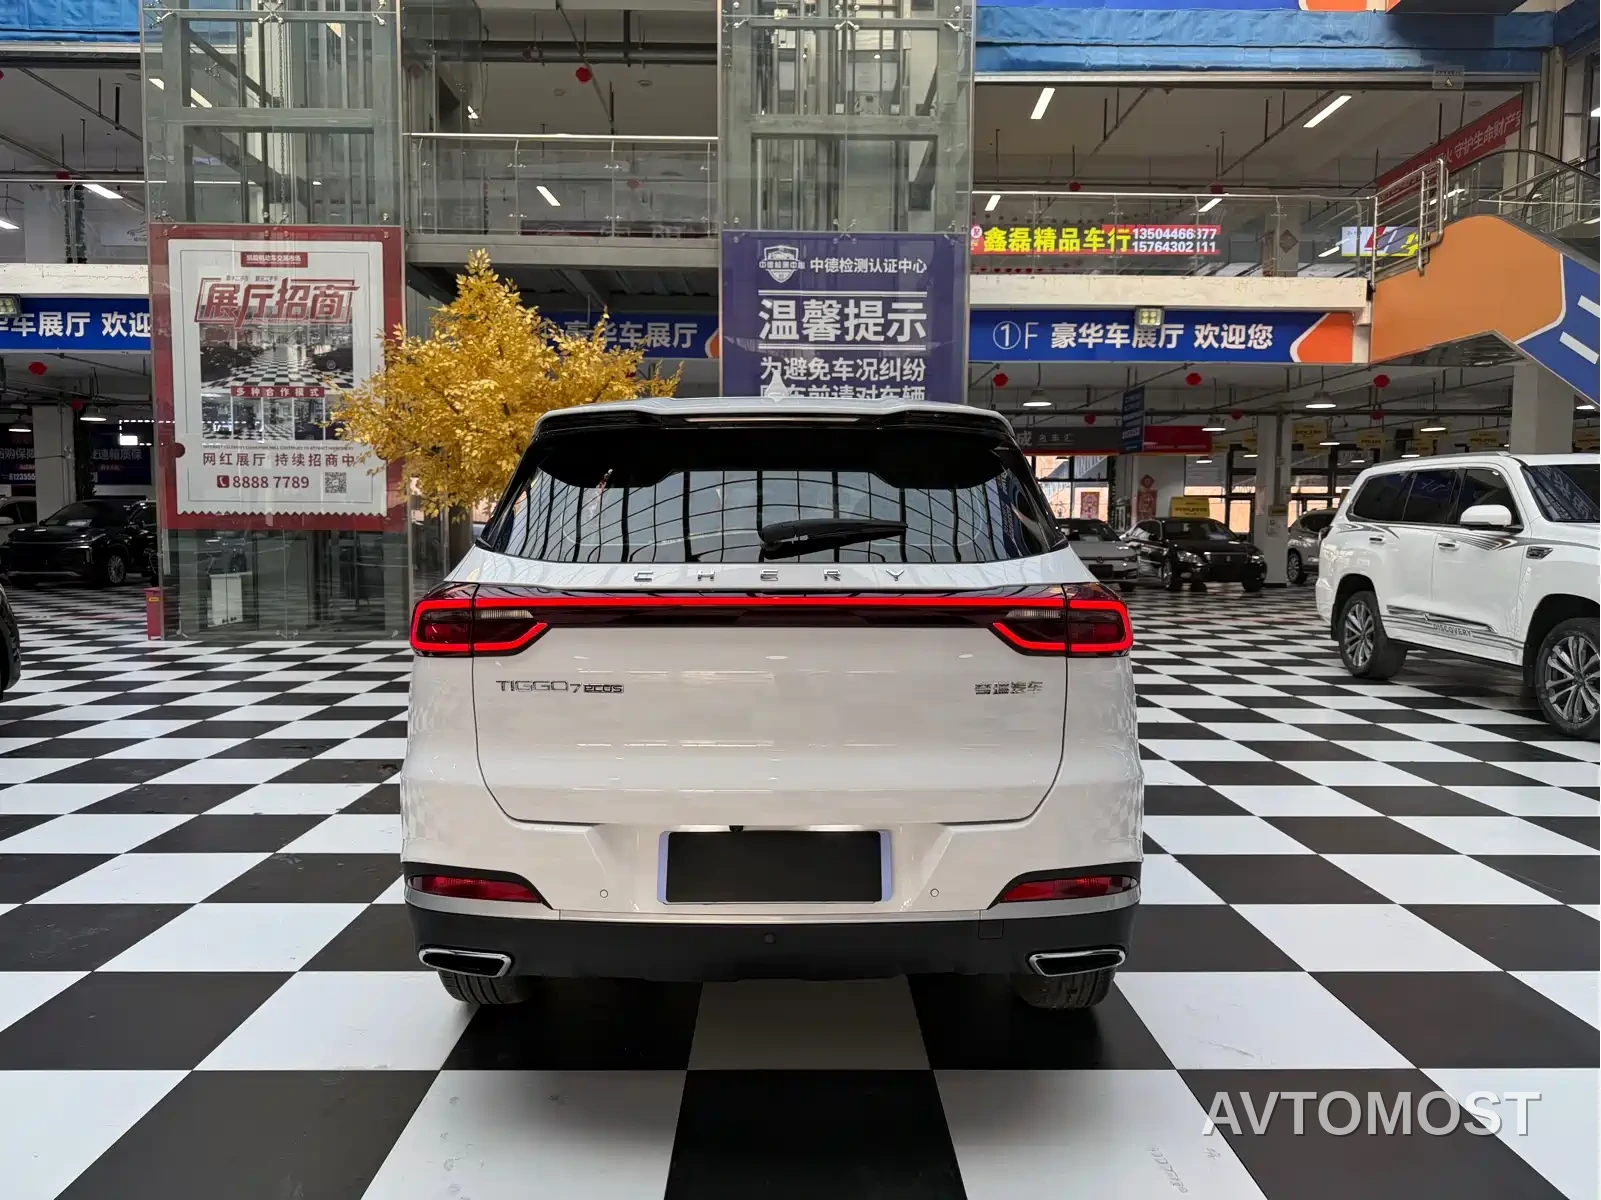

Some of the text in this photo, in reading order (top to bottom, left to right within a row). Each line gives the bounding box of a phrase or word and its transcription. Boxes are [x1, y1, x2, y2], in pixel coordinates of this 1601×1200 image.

[983, 227, 1131, 253] 鑫磊精品车行
[1132, 241, 1216, 253] 15764302111
[810, 257, 928, 274] 中德检测认证中心
[204, 277, 361, 329] 展厅招商
[758, 299, 928, 342] 温馨提示
[1051, 322, 1185, 349] 豪华车展厅
[1193, 323, 1274, 350] 欢迎您
[760, 356, 926, 382] 为避免车况纠纷
[236, 387, 320, 397] 多种合作模式
[760, 384, 926, 400] 前请对车辆
[203, 452, 355, 468] 网红展厅 持续招商中
[232, 475, 310, 489] 8888 7789
[633, 569, 905, 582] CHERY
[496, 680, 568, 692] TIGGO
